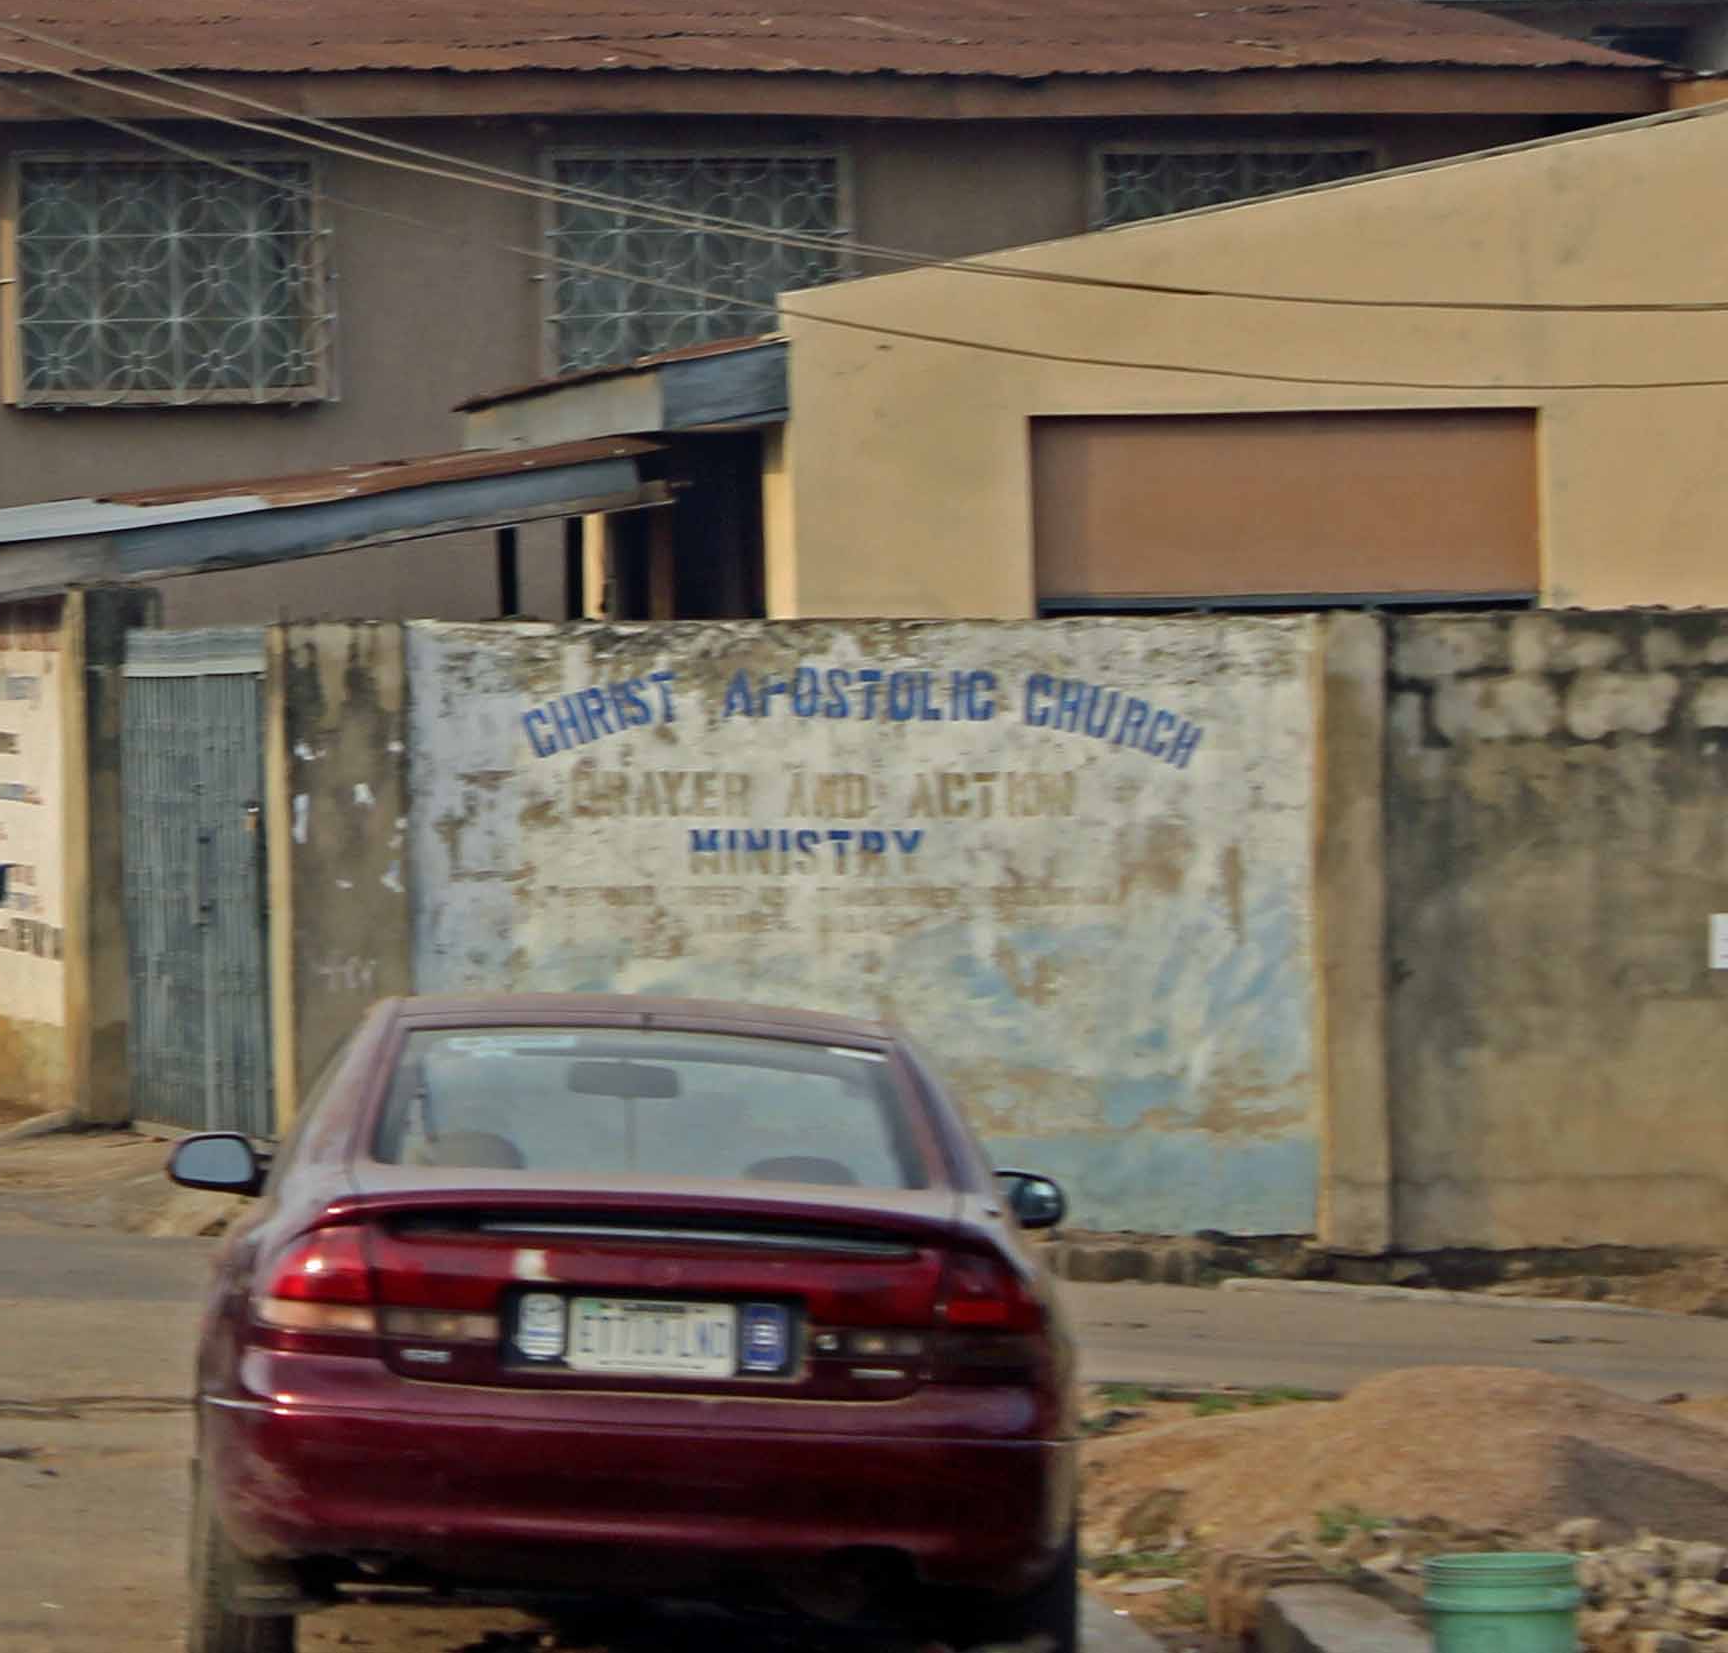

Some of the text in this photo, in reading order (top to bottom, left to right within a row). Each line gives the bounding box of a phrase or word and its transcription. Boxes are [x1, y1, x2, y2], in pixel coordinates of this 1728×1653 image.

[520, 670, 680, 759] CHRIST
[1023, 672, 1205, 770] CHURCH
[784, 770, 876, 820] AND
[906, 771, 1080, 821] ACTION
[688, 828, 926, 877] MINISTRY
